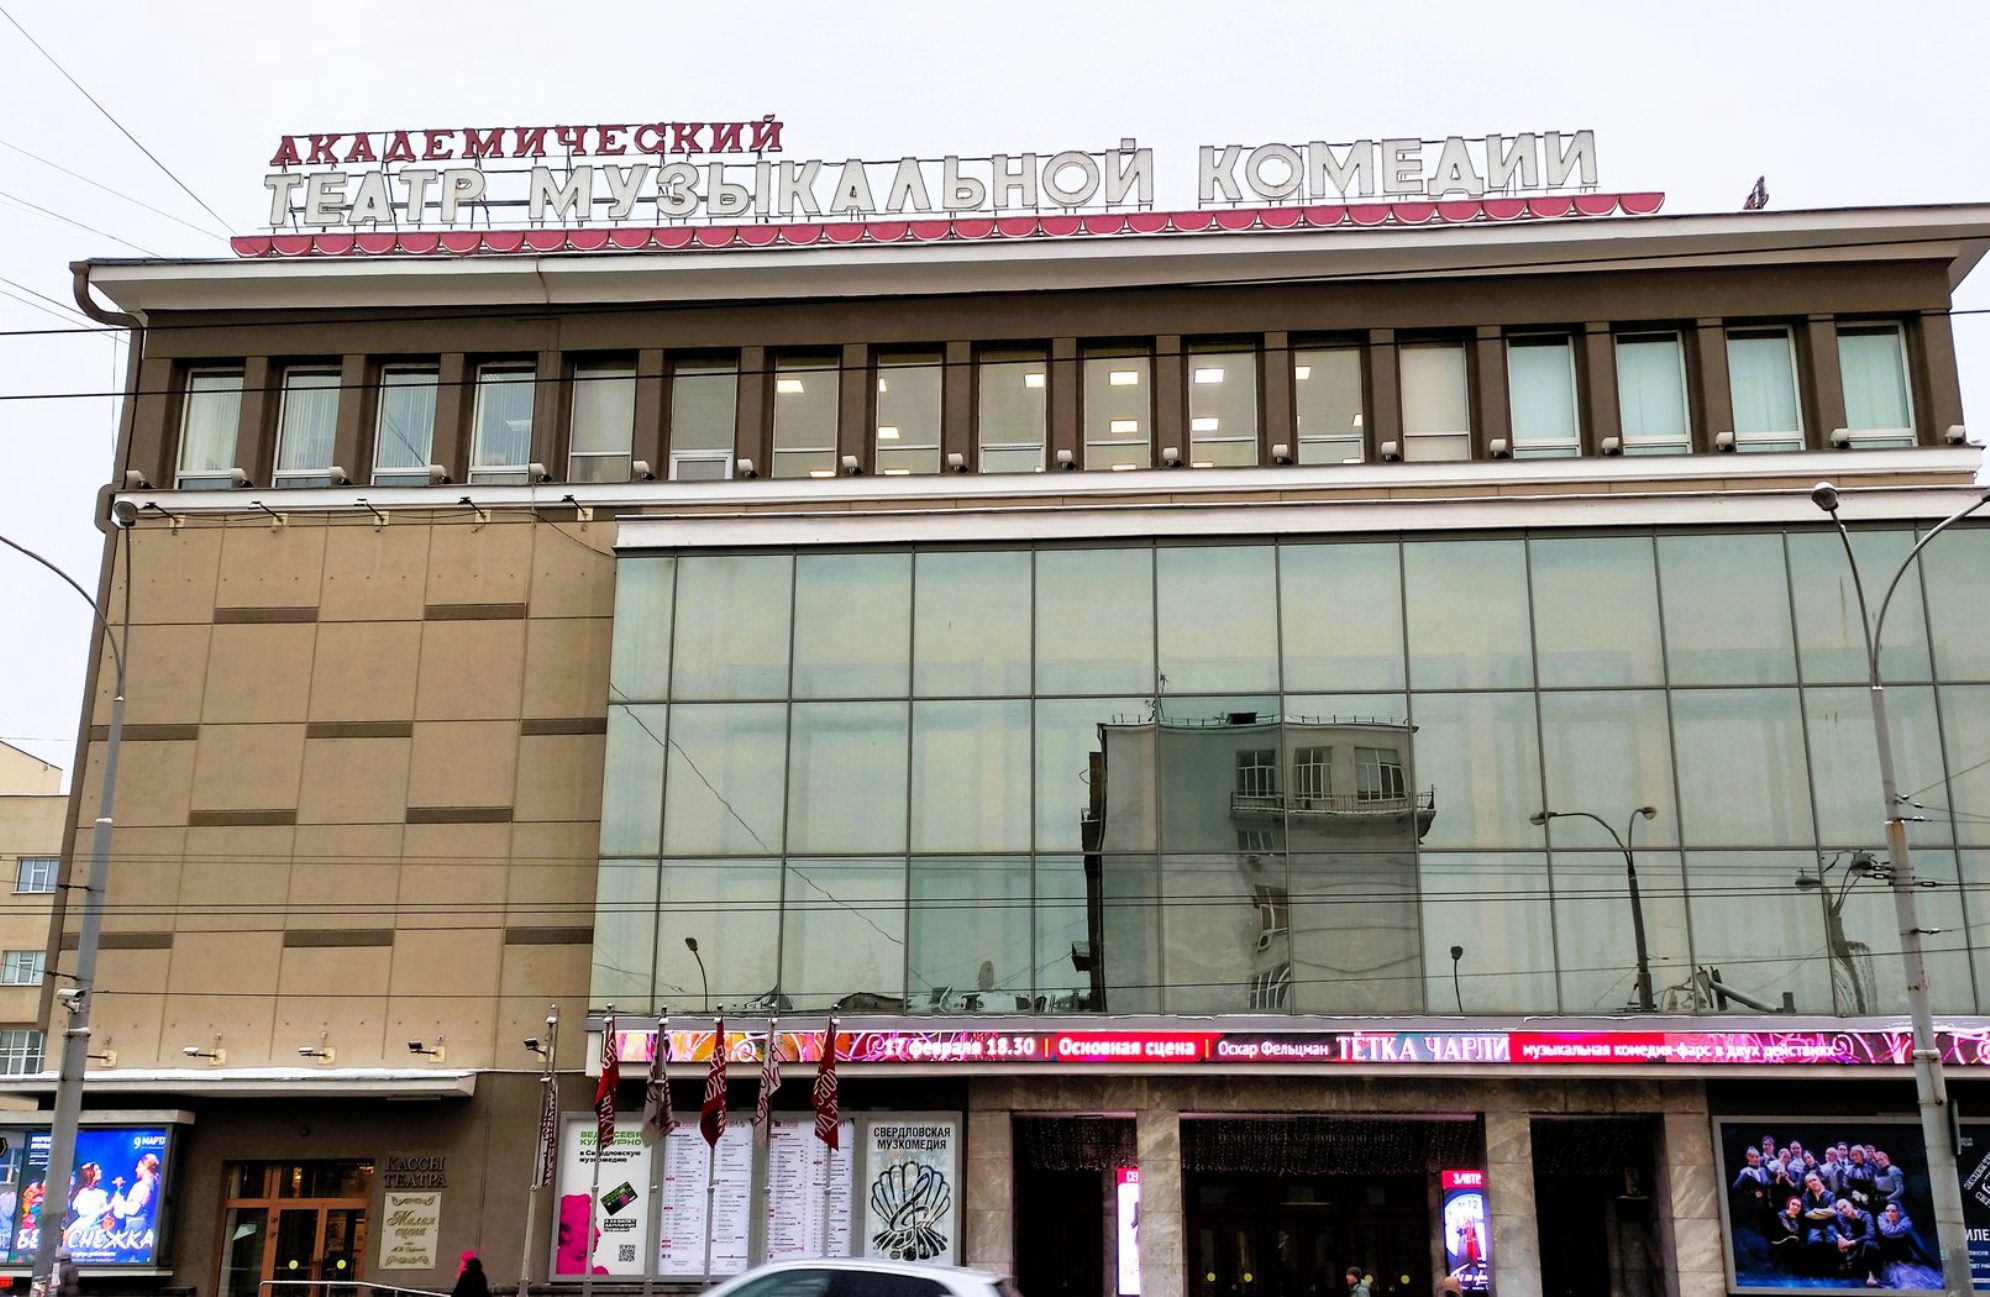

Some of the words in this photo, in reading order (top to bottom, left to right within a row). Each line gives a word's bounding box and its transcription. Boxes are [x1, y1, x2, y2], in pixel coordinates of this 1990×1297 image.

[270, 114, 783, 165] АКАДЕМИЧЕСКИЙ
[264, 167, 487, 226] ТЕАТР
[529, 138, 1154, 221] МУЗЫКАЛЬНОЙ
[1199, 130, 1598, 201] КОМЕДИИ
[885, 1037, 903, 1055] 17
[908, 1036, 982, 1059] февраля
[987, 1036, 1035, 1055] 18.30
[1059, 1038, 1140, 1055] Основная
[1145, 1041, 1195, 1057] сцена
[1218, 1041, 1256, 1058] Оскар
[1261, 1041, 1328, 1057] Фельцман
[1337, 1032, 1418, 1061] ТЁТКА
[1424, 1036, 1510, 1061] ЧАРЛИ
[1523, 1044, 1611, 1057] музыкальная
[1614, 1042, 1711, 1059] комедия-фарс
[1716, 1046, 1723, 1055] в
[1726, 1045, 1759, 1059] двух
[1763, 1042, 1835, 1059] действиях
[874, 1127, 951, 1138] СВЕРДЛОВСКАЯ
[133, 1136, 141, 1150] 9
[877, 1139, 947, 1150] МУЗКОМЕДИЯ
[385, 1157, 447, 1172] КАССЫ
[384, 1173, 447, 1188] ТЕАТРА
